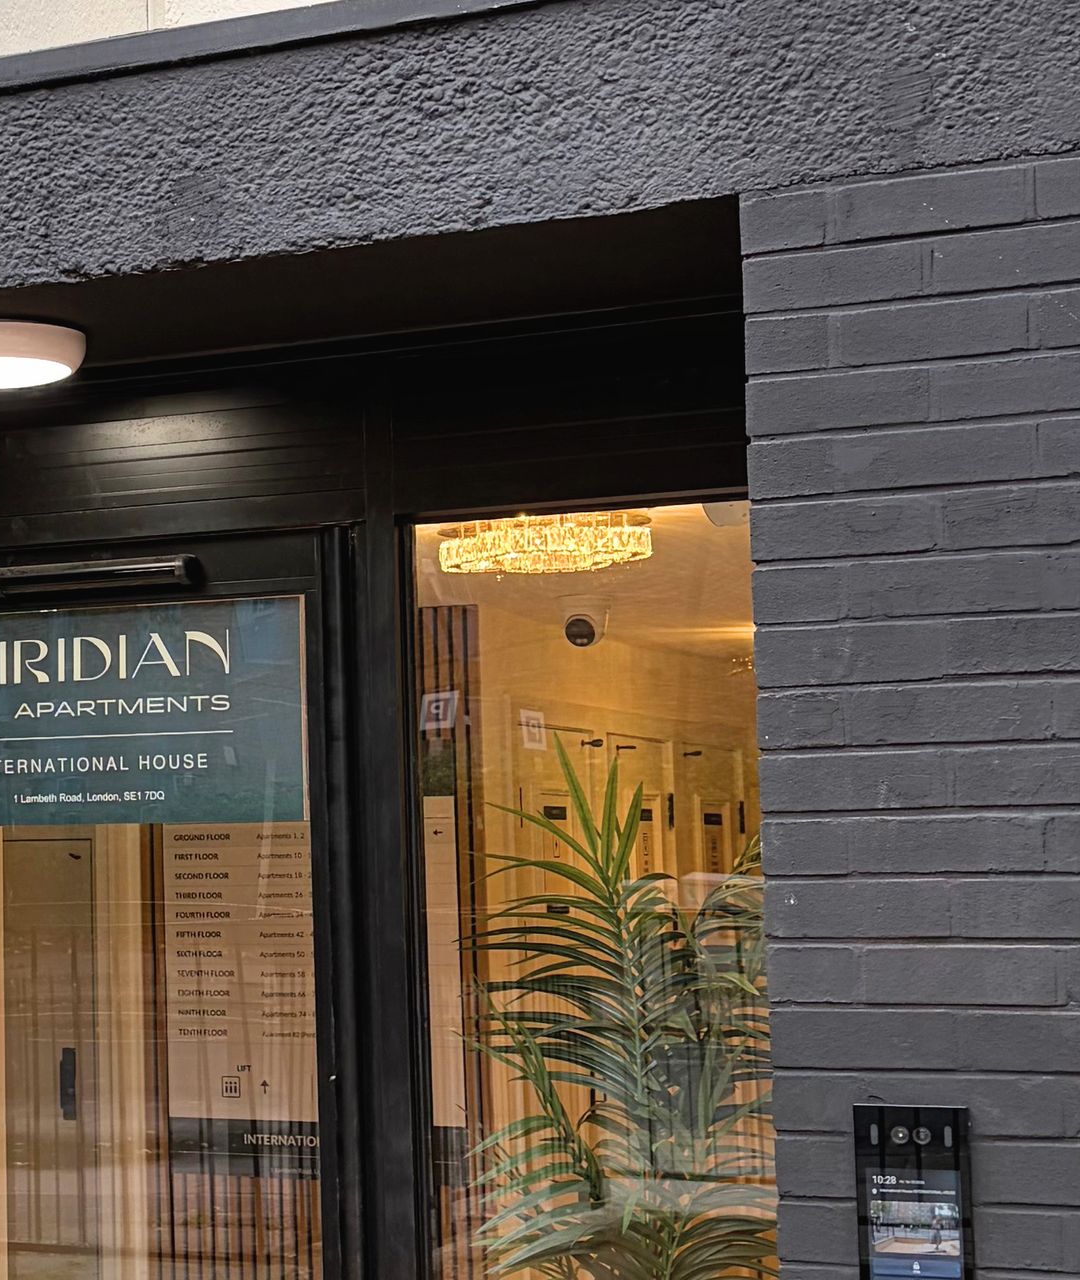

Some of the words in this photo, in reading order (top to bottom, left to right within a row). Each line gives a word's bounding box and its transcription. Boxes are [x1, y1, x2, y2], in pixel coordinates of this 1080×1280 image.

[14, 694, 231, 719] APARTMENTS
[138, 753, 208, 770] HOUSE
[13, 794, 18, 803] 1
[20, 793, 57, 803] Lambeth
[59, 792, 85, 803] Road,
[87, 791, 122, 802] London,
[123, 791, 142, 800] SE1
[144, 790, 165, 801] 7DQ
[173, 833, 205, 841] GROUND
[206, 833, 230, 841] FLOOR
[174, 853, 193, 861] FIRST
[194, 852, 219, 861] FLOOR
[174, 872, 204, 880] SECOND
[205, 872, 229, 880] FLOOR
[175, 891, 198, 899] THIRD
[198, 891, 223, 899] FLOOR
[206, 911, 230, 919] FLOOR
[197, 930, 222, 938] FLOOR
[198, 950, 223, 958] FLOOR
[177, 969, 209, 977] SEVENTH
[210, 969, 235, 978] FLOOR
[205, 989, 231, 997] FLOOR
[202, 1008, 227, 1017] FLOOR
[203, 1028, 228, 1037] FLOOR
[236, 1064, 252, 1073] LIFT
[872, 1175, 897, 1184] 10:28
